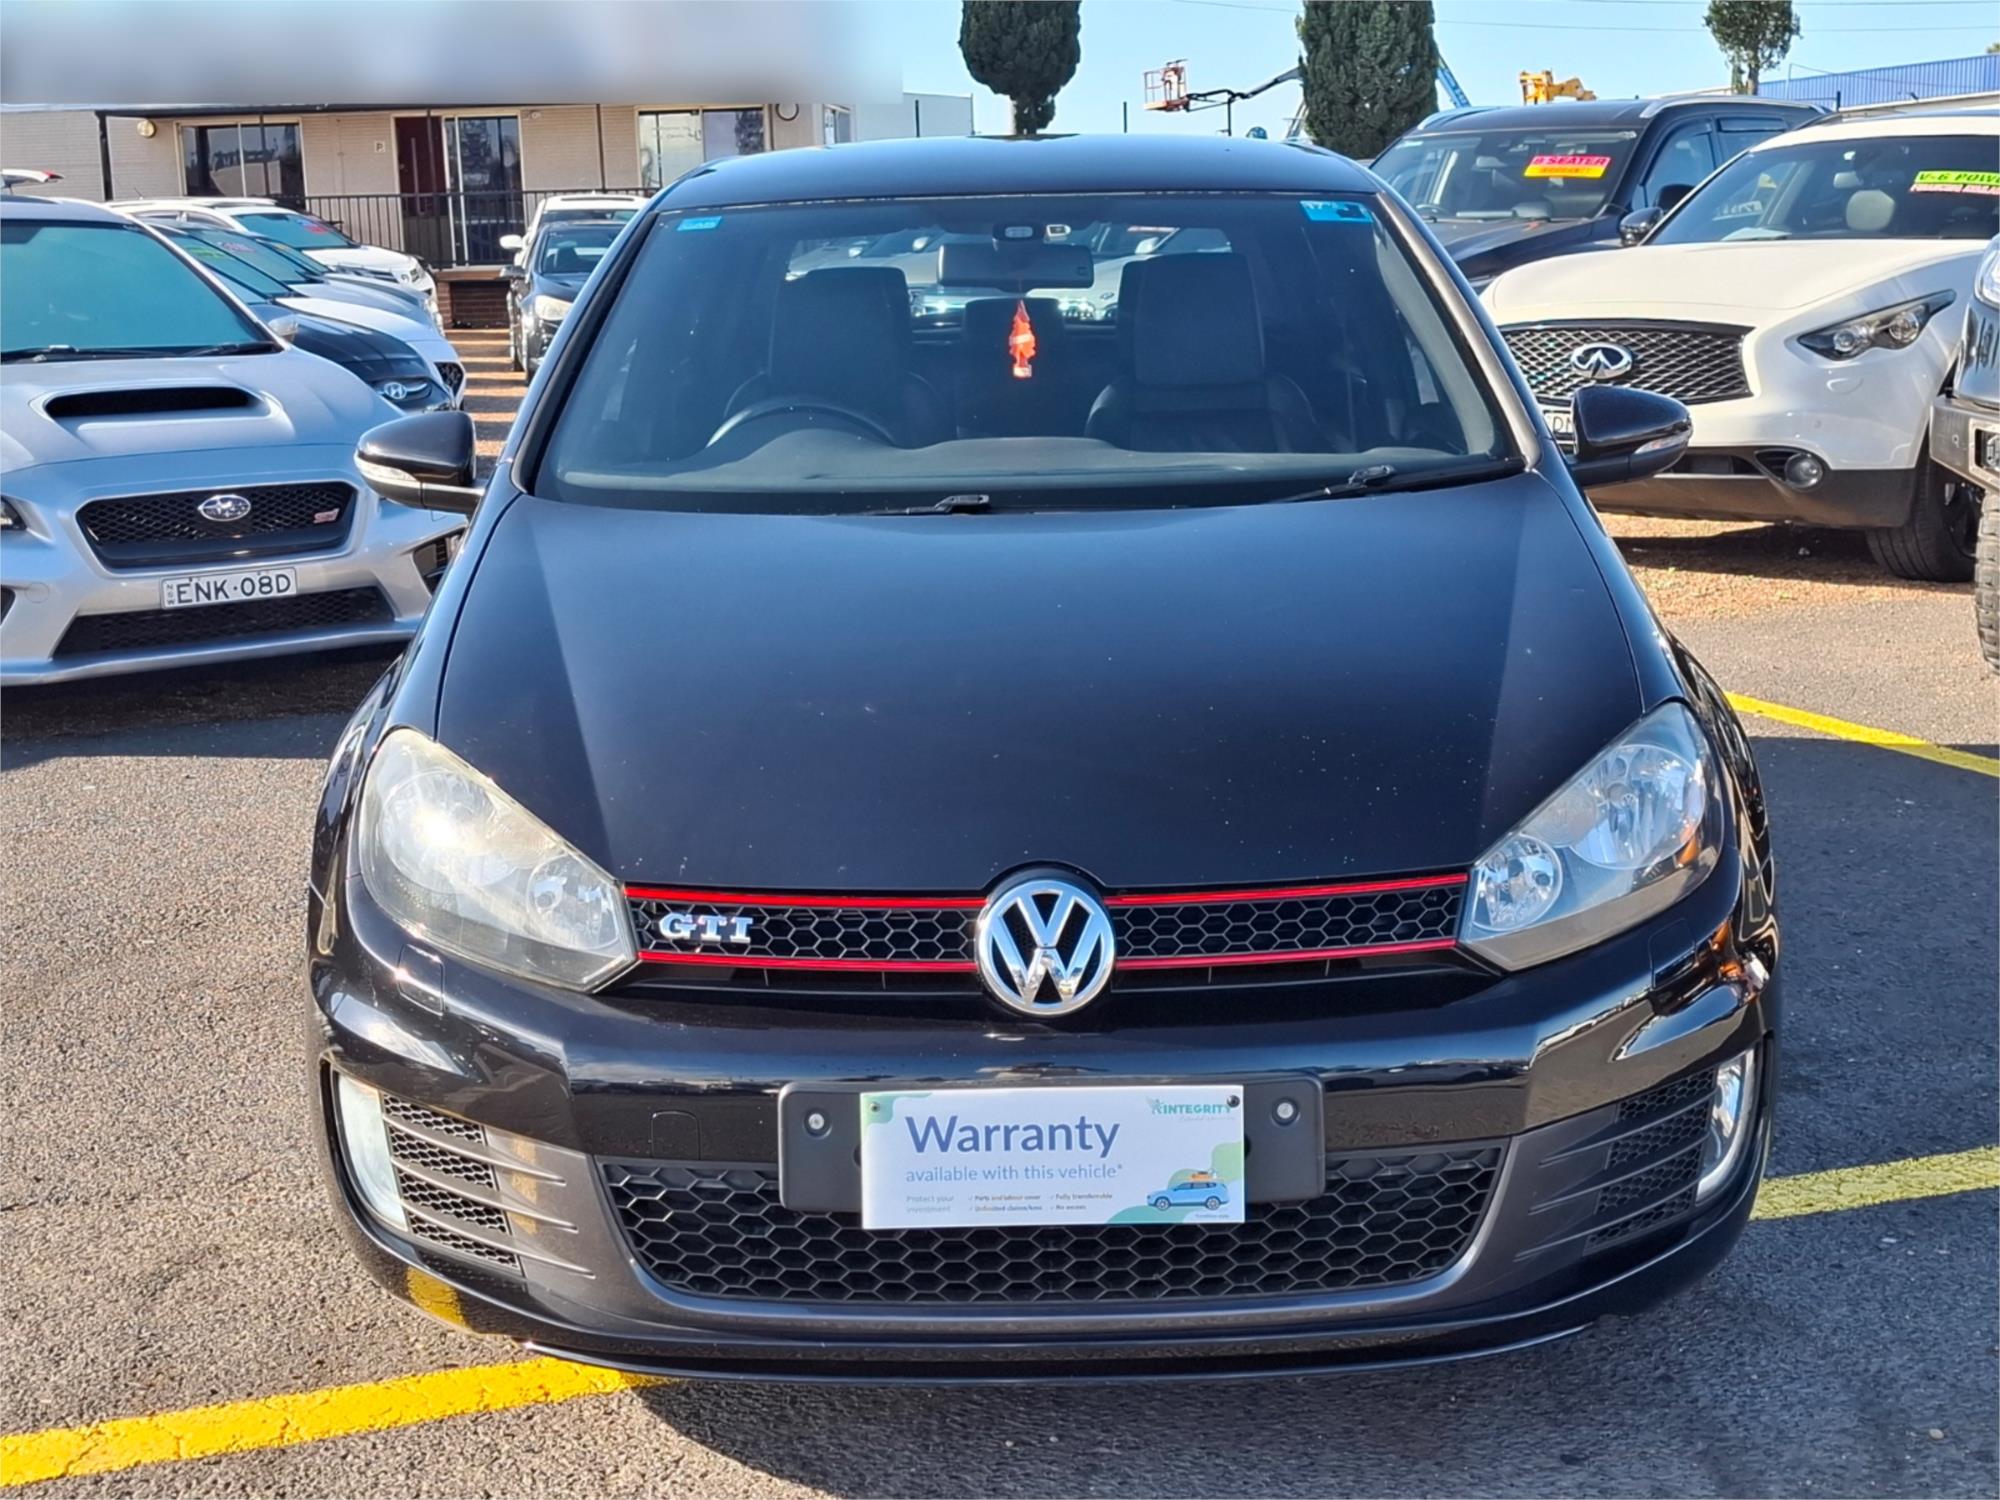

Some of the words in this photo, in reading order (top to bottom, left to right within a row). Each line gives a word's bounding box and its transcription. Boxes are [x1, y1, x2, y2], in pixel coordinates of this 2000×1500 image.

[1547, 156, 1606, 164] SEATER
[658, 912, 754, 944] GTI
[904, 1115, 1121, 1158] Warranty
[905, 1166, 978, 1183] available
[982, 1164, 1019, 1181] with
[1023, 1163, 1054, 1180] this
